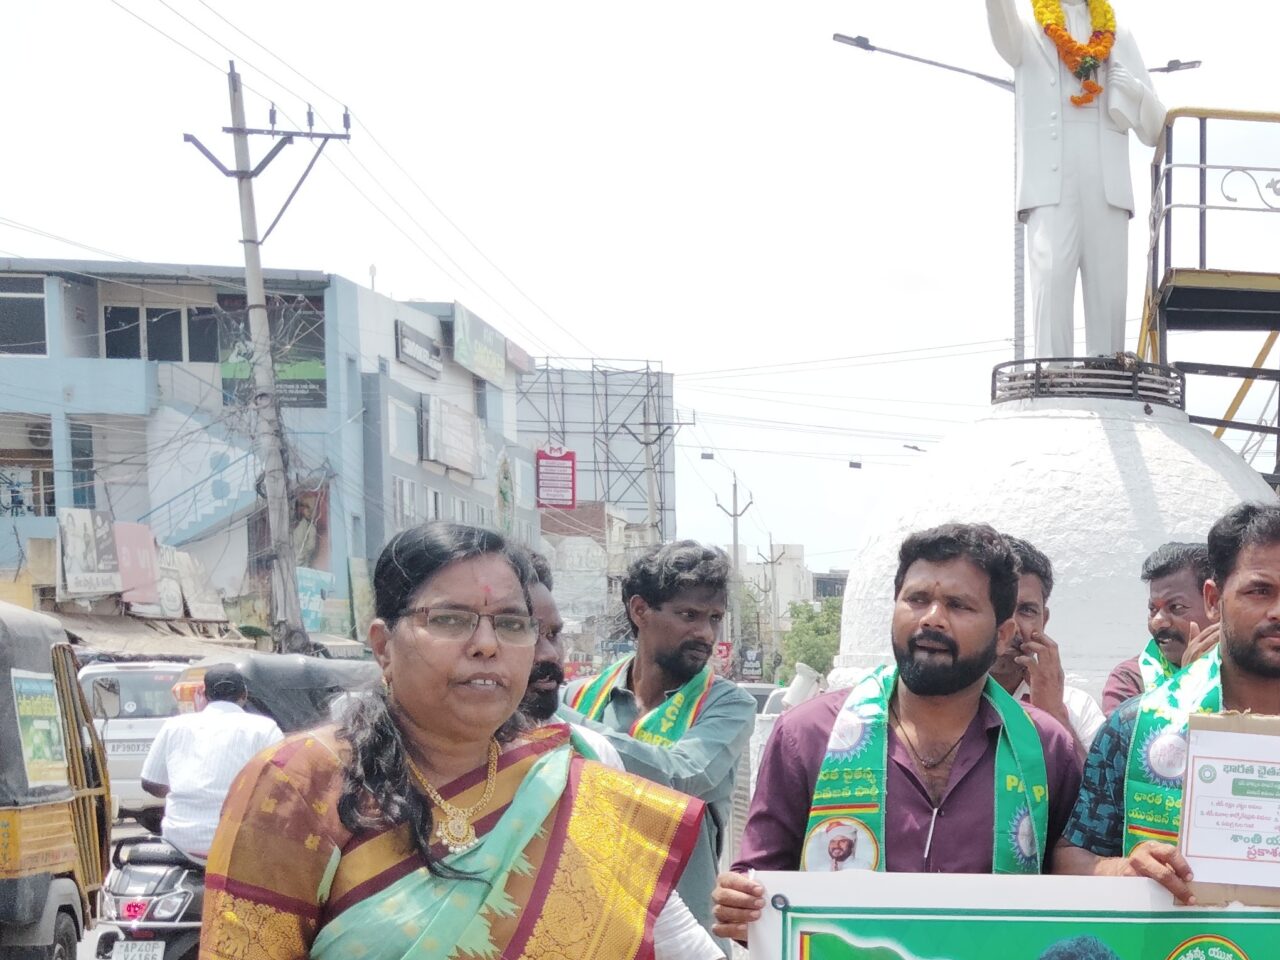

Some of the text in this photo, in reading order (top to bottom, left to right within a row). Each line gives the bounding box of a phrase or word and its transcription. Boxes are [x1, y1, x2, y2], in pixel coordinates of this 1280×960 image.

[661, 692, 685, 733] BCY
[1223, 763, 1254, 775] భారత
[1134, 792, 1162, 805] భారత
[1128, 807, 1169, 824] యువజన
